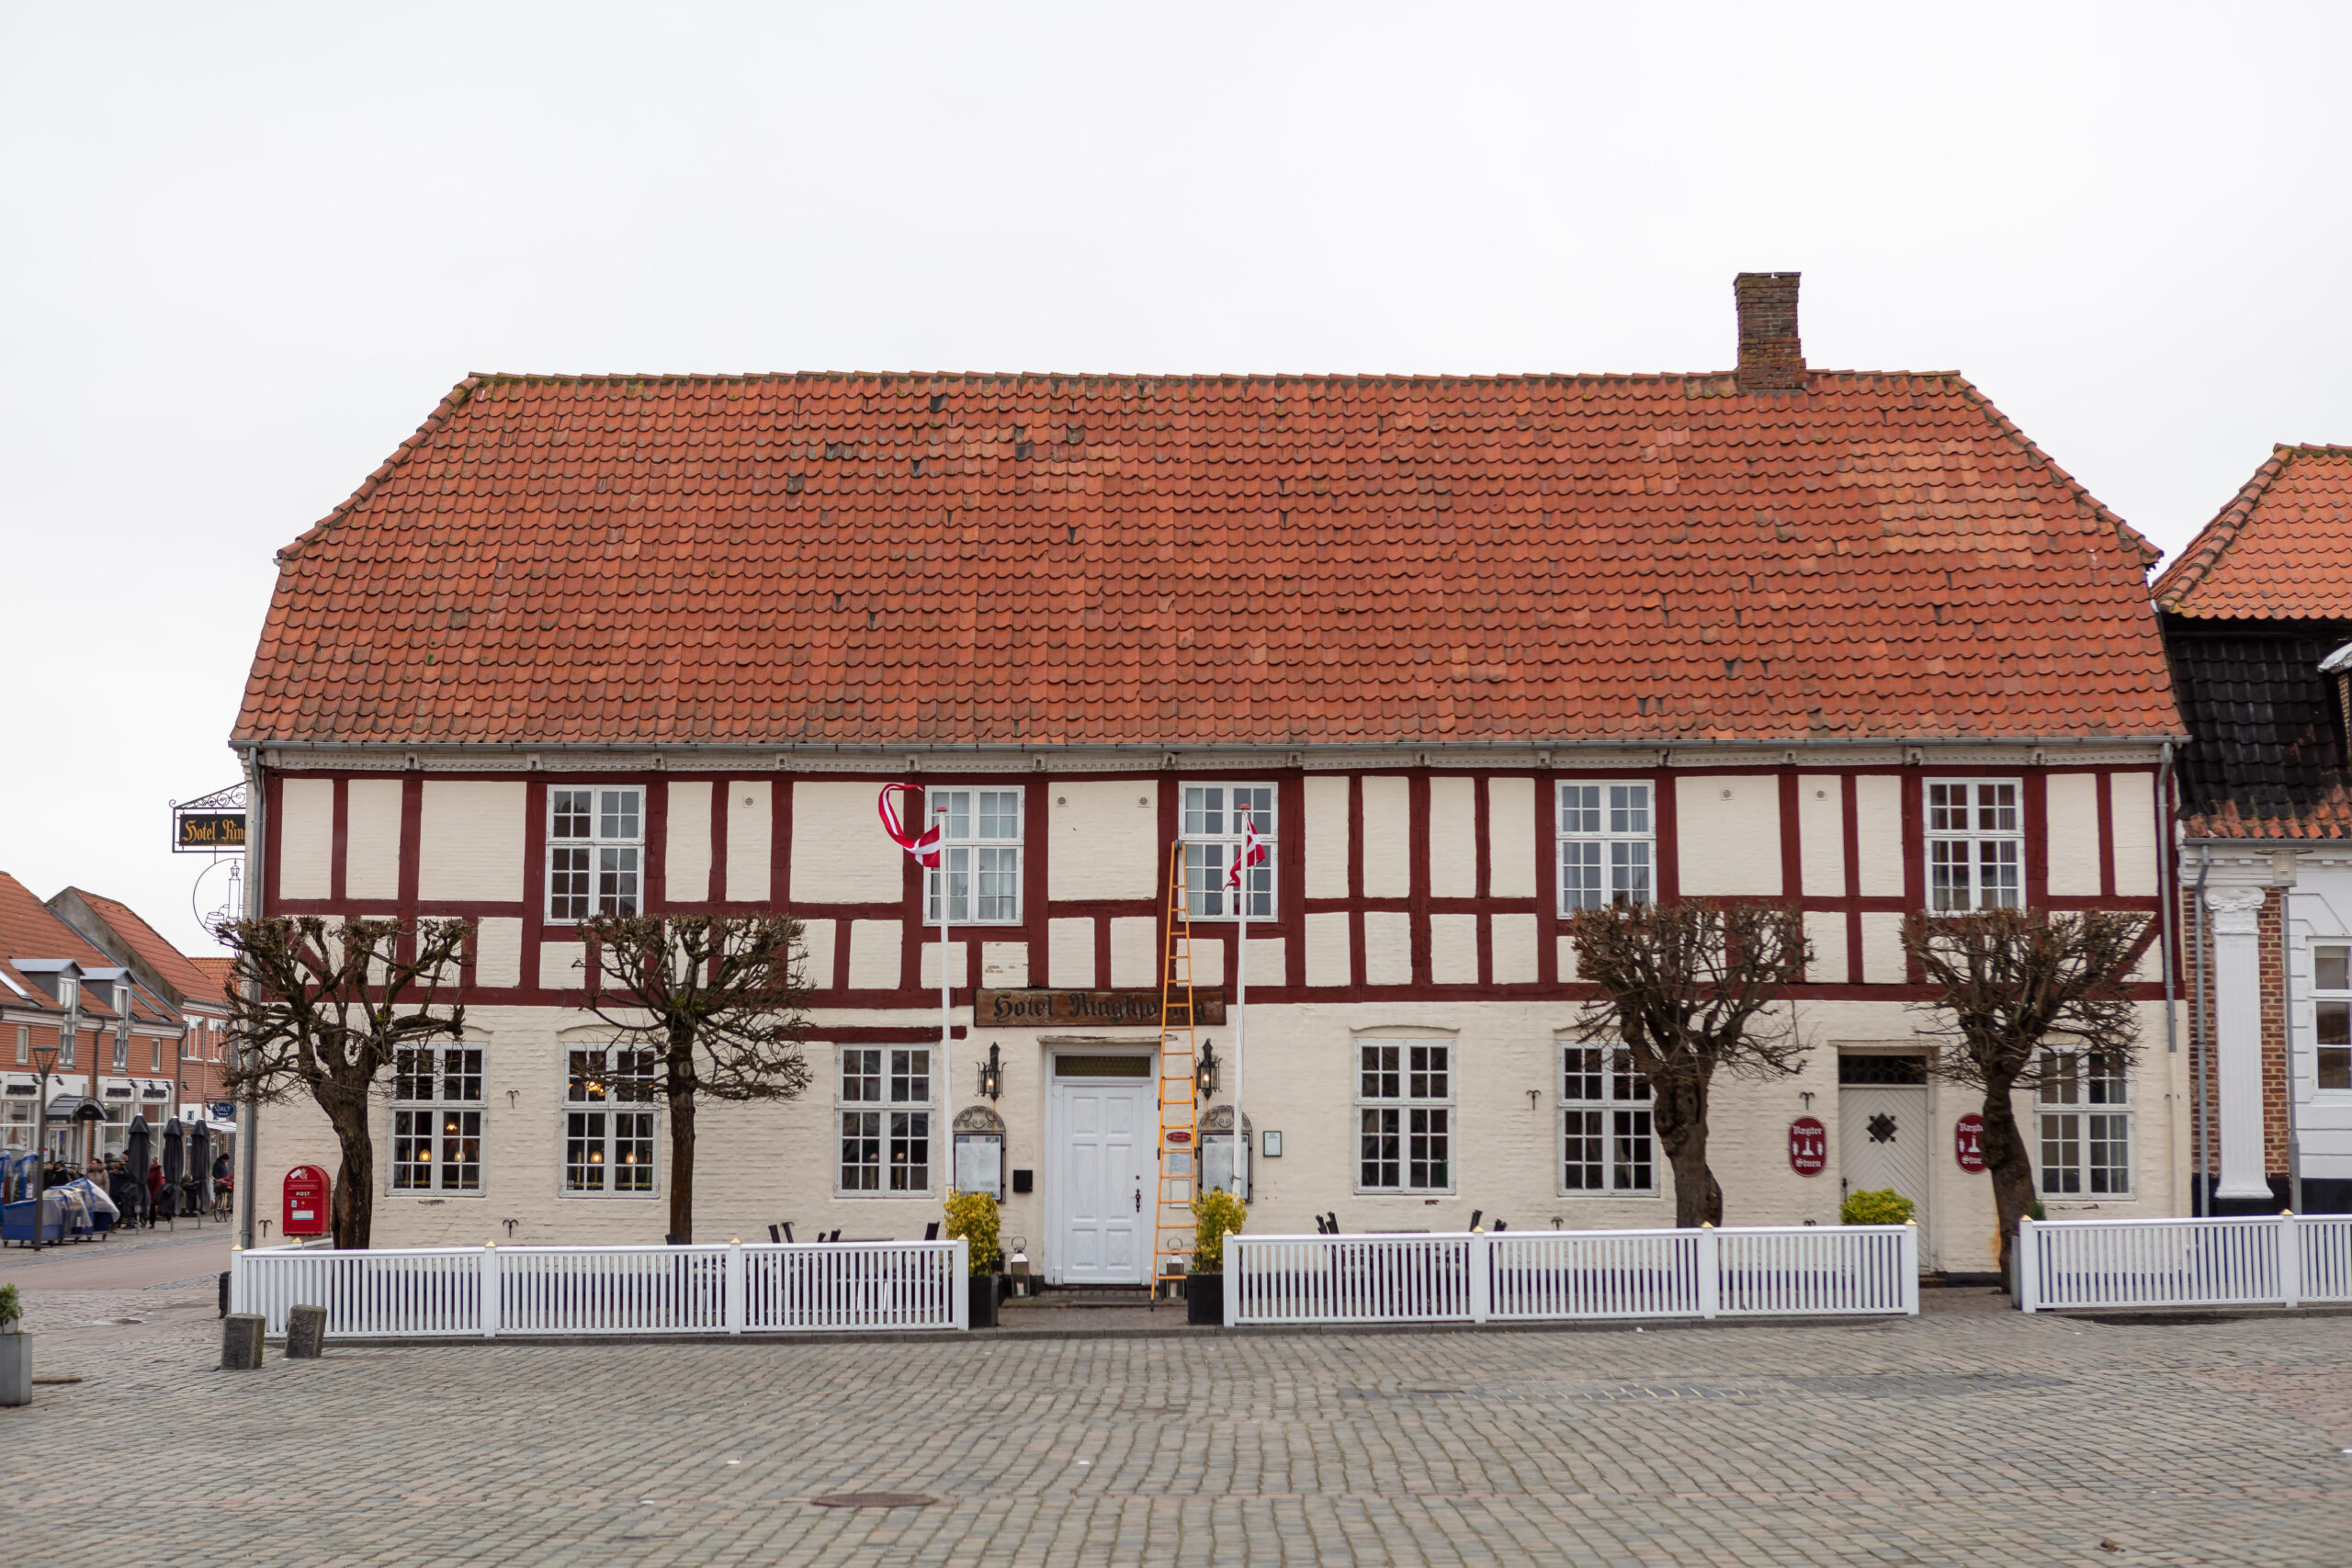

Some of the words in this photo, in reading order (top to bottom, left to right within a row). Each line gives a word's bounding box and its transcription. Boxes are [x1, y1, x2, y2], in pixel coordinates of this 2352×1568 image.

[182, 819, 218, 842] Hotel
[220, 819, 245, 840] Rin
[993, 992, 1054, 1022] Hotel
